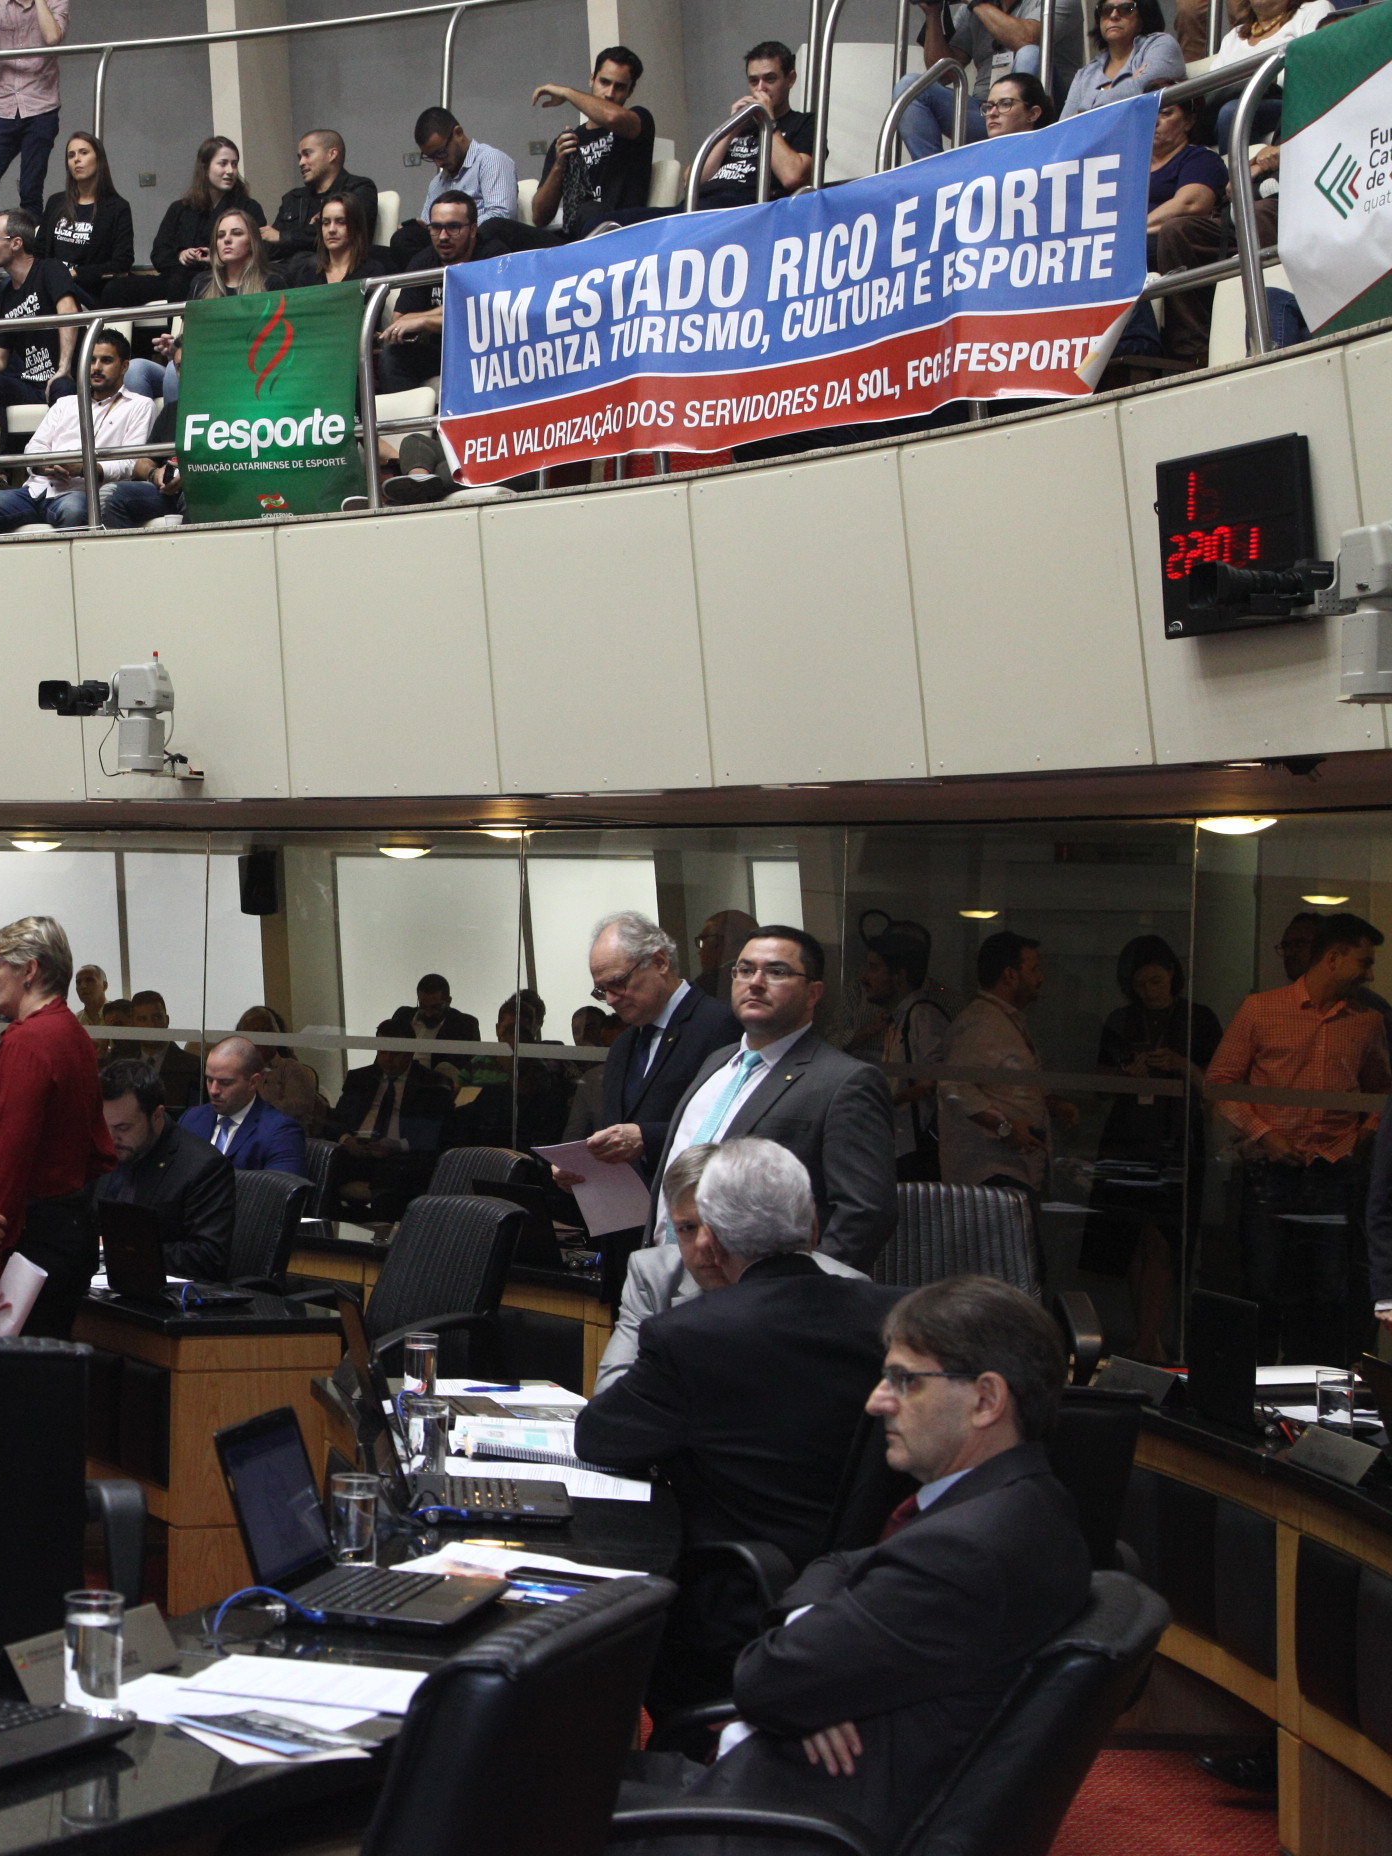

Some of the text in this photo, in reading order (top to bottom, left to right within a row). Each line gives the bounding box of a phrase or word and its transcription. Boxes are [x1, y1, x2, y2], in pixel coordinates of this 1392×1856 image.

[1366, 170, 1386, 190] de
[466, 153, 1121, 354] UM ESTADO RICO E FORTE
[470, 232, 1116, 394] VALORIZA TURISMO, CULTURA E ESPORTE
[183, 408, 346, 458] Fesporte
[463, 434, 508, 465] PELA
[513, 404, 622, 452] VALORIZAÇÃO
[626, 400, 675, 429] DOS
[683, 385, 818, 429] SERVIDORES
[823, 380, 852, 409] DA
[857, 366, 900, 402] SOL,
[908, 352, 942, 391] FCC
[943, 347, 952, 378] E
[187, 457, 347, 474] FUNDAÇÃO CATARINENSE DE ESPORTE
